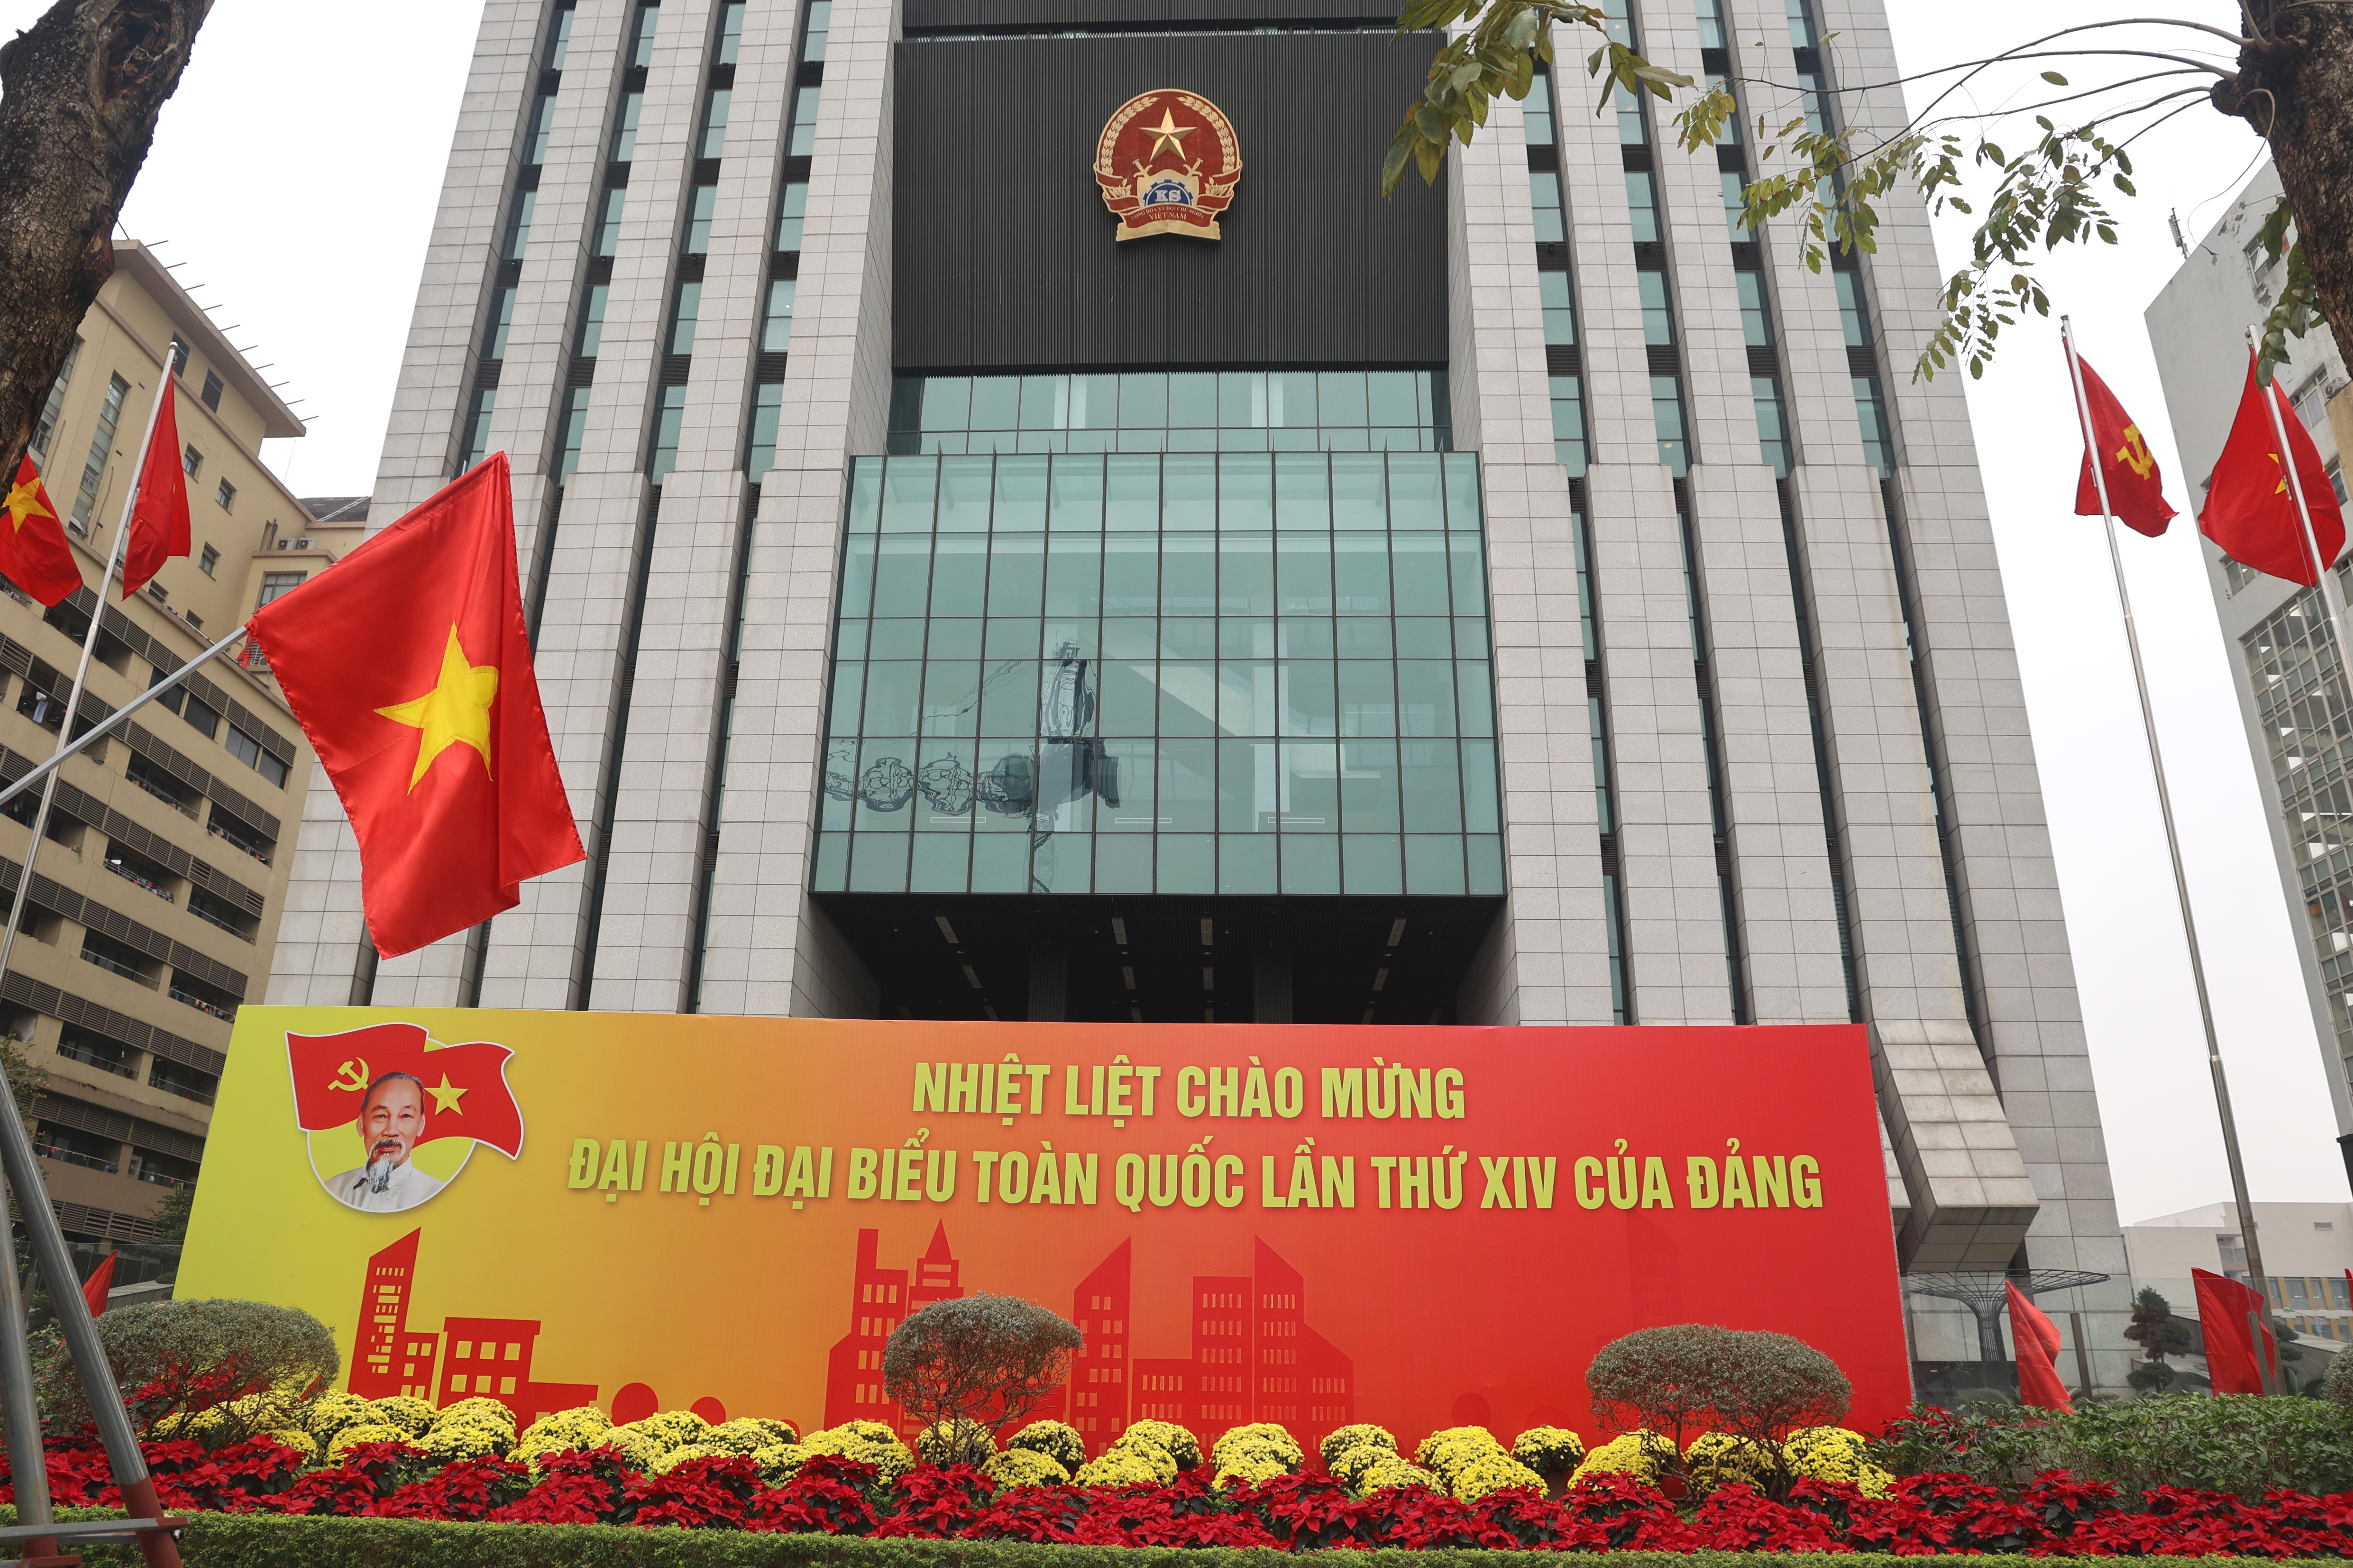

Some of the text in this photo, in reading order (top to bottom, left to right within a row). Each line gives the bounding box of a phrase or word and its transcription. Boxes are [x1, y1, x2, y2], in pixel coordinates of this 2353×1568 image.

[1149, 211, 1167, 220] VIỆT
[1155, 190, 1181, 202] KS
[913, 1053, 1465, 1127] NHIỆT LIỆT CHÀO MỪNG
[568, 1127, 1823, 1212] ĐẠI HỘI ĐẠI BIỂU TOÀN QUỐC LẦN THỨ XIV CỦA ĐẢNG
